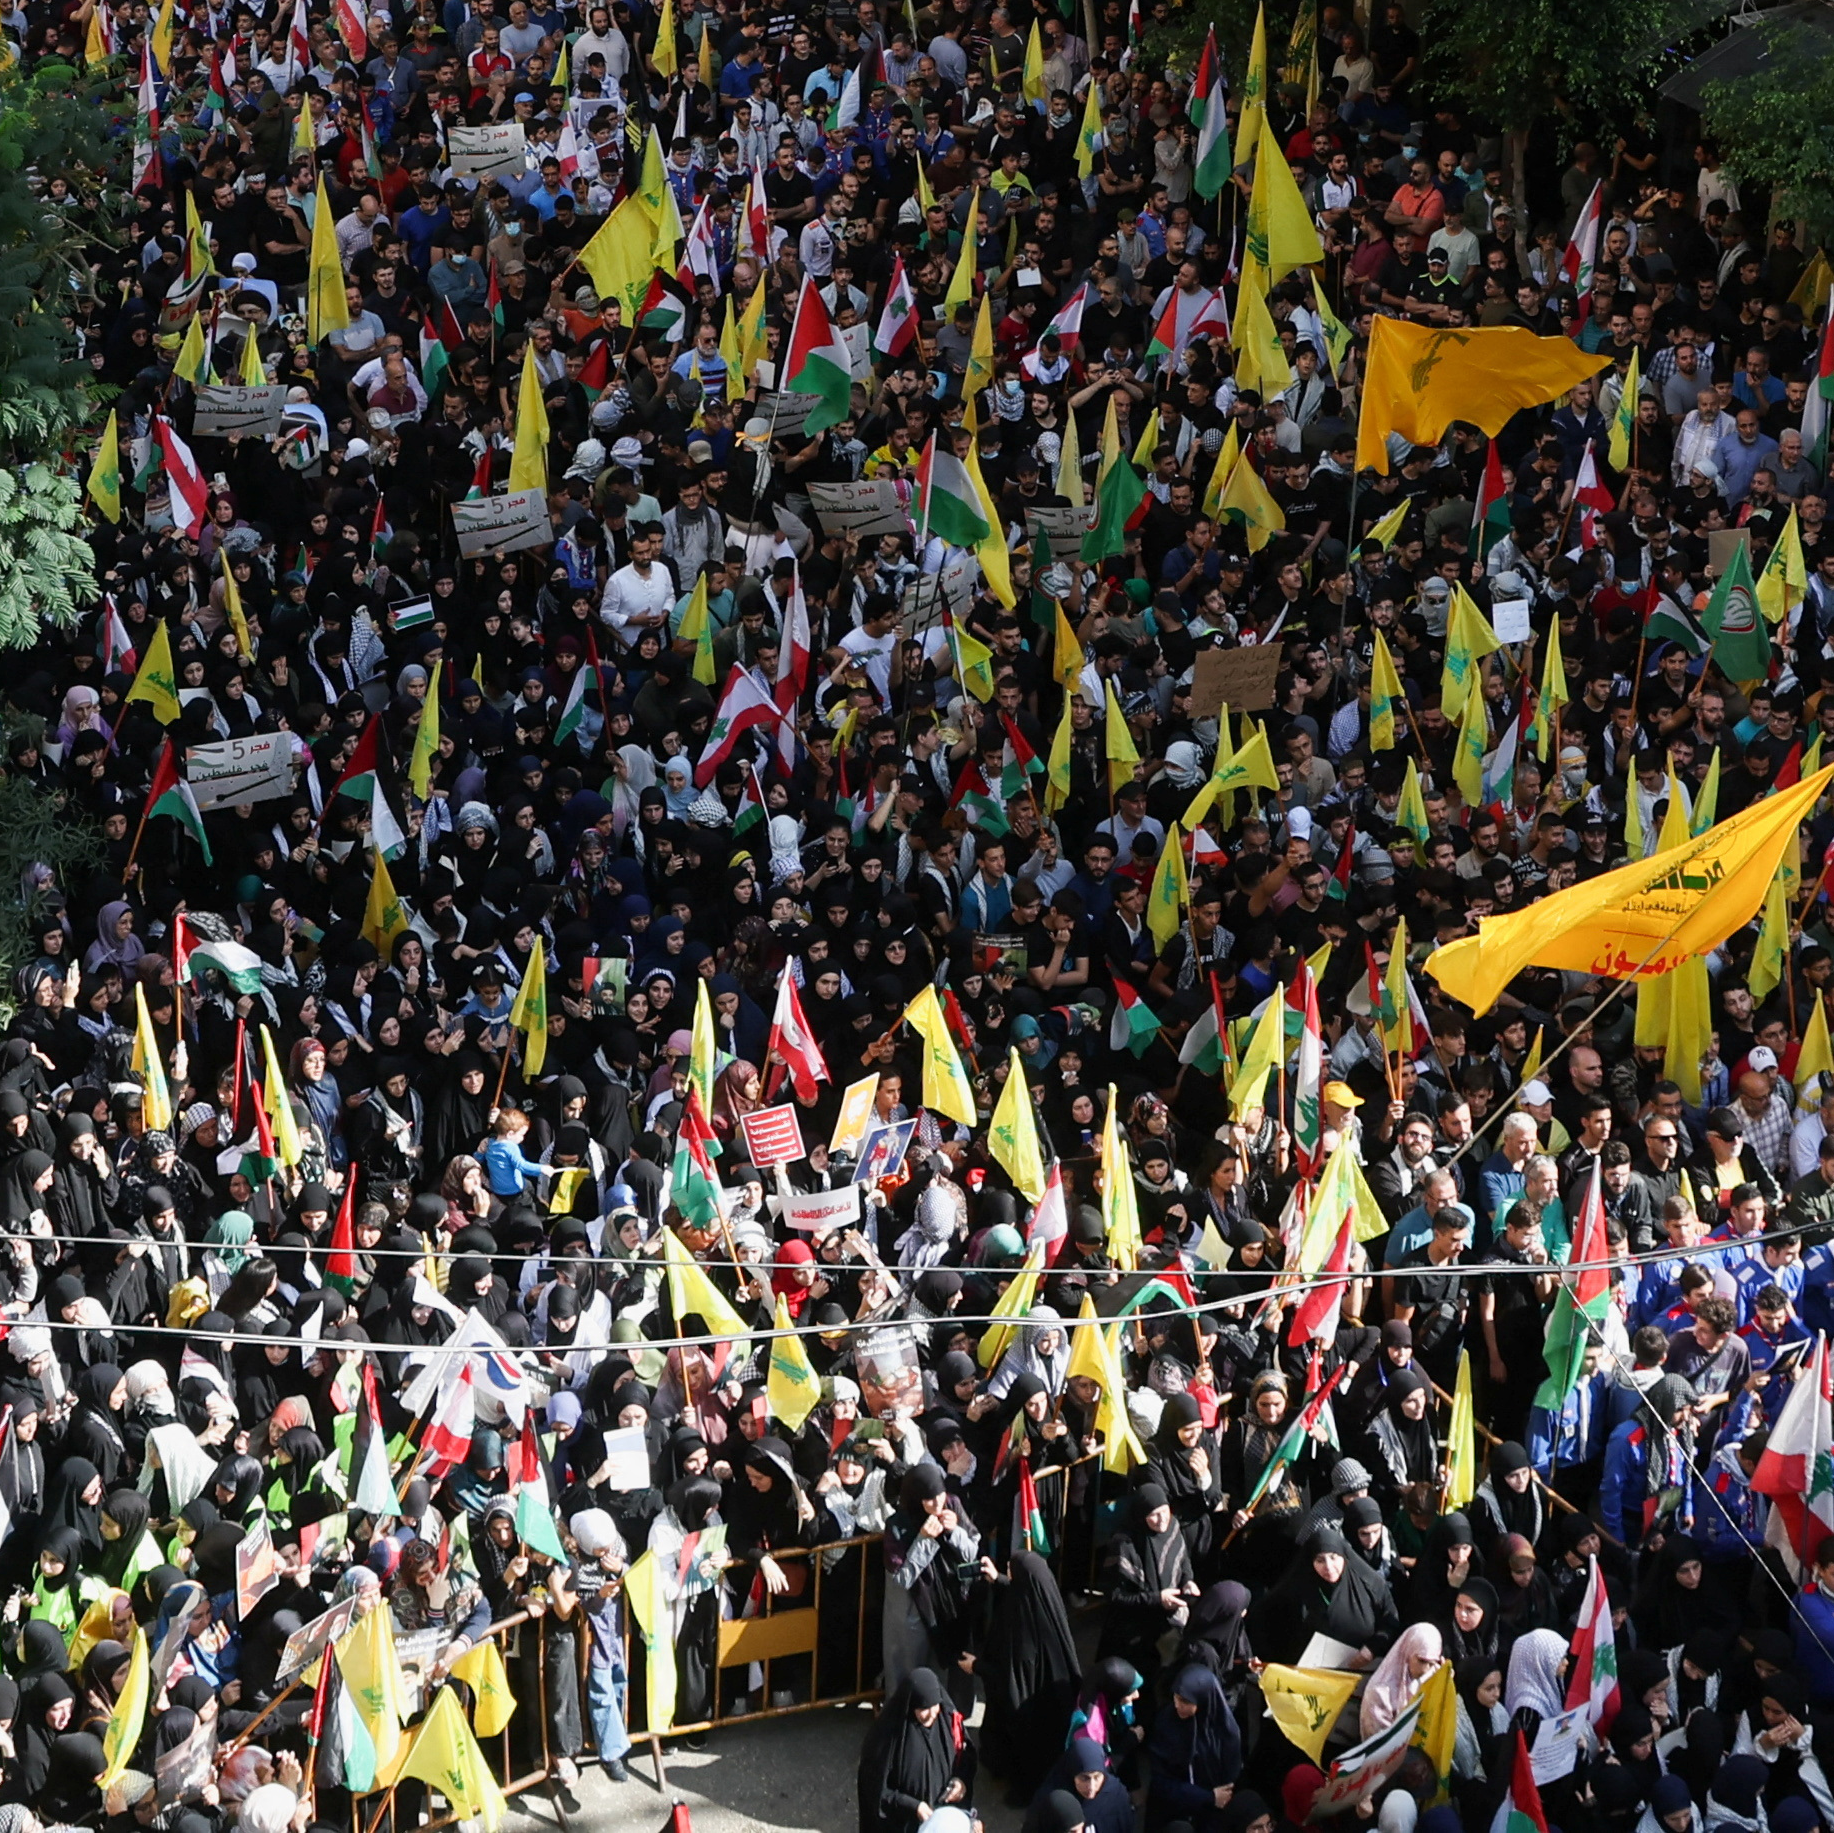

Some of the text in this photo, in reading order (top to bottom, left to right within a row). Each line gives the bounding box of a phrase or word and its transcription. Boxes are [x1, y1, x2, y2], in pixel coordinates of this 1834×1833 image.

[480, 128, 490, 143] 5
[236, 388, 248, 402] 5
[842, 484, 855, 500] 5
[490, 497, 527, 514] فجر 5
[232, 740, 271, 760] فجر 5
[196, 761, 270, 782] فجر فلسطين
